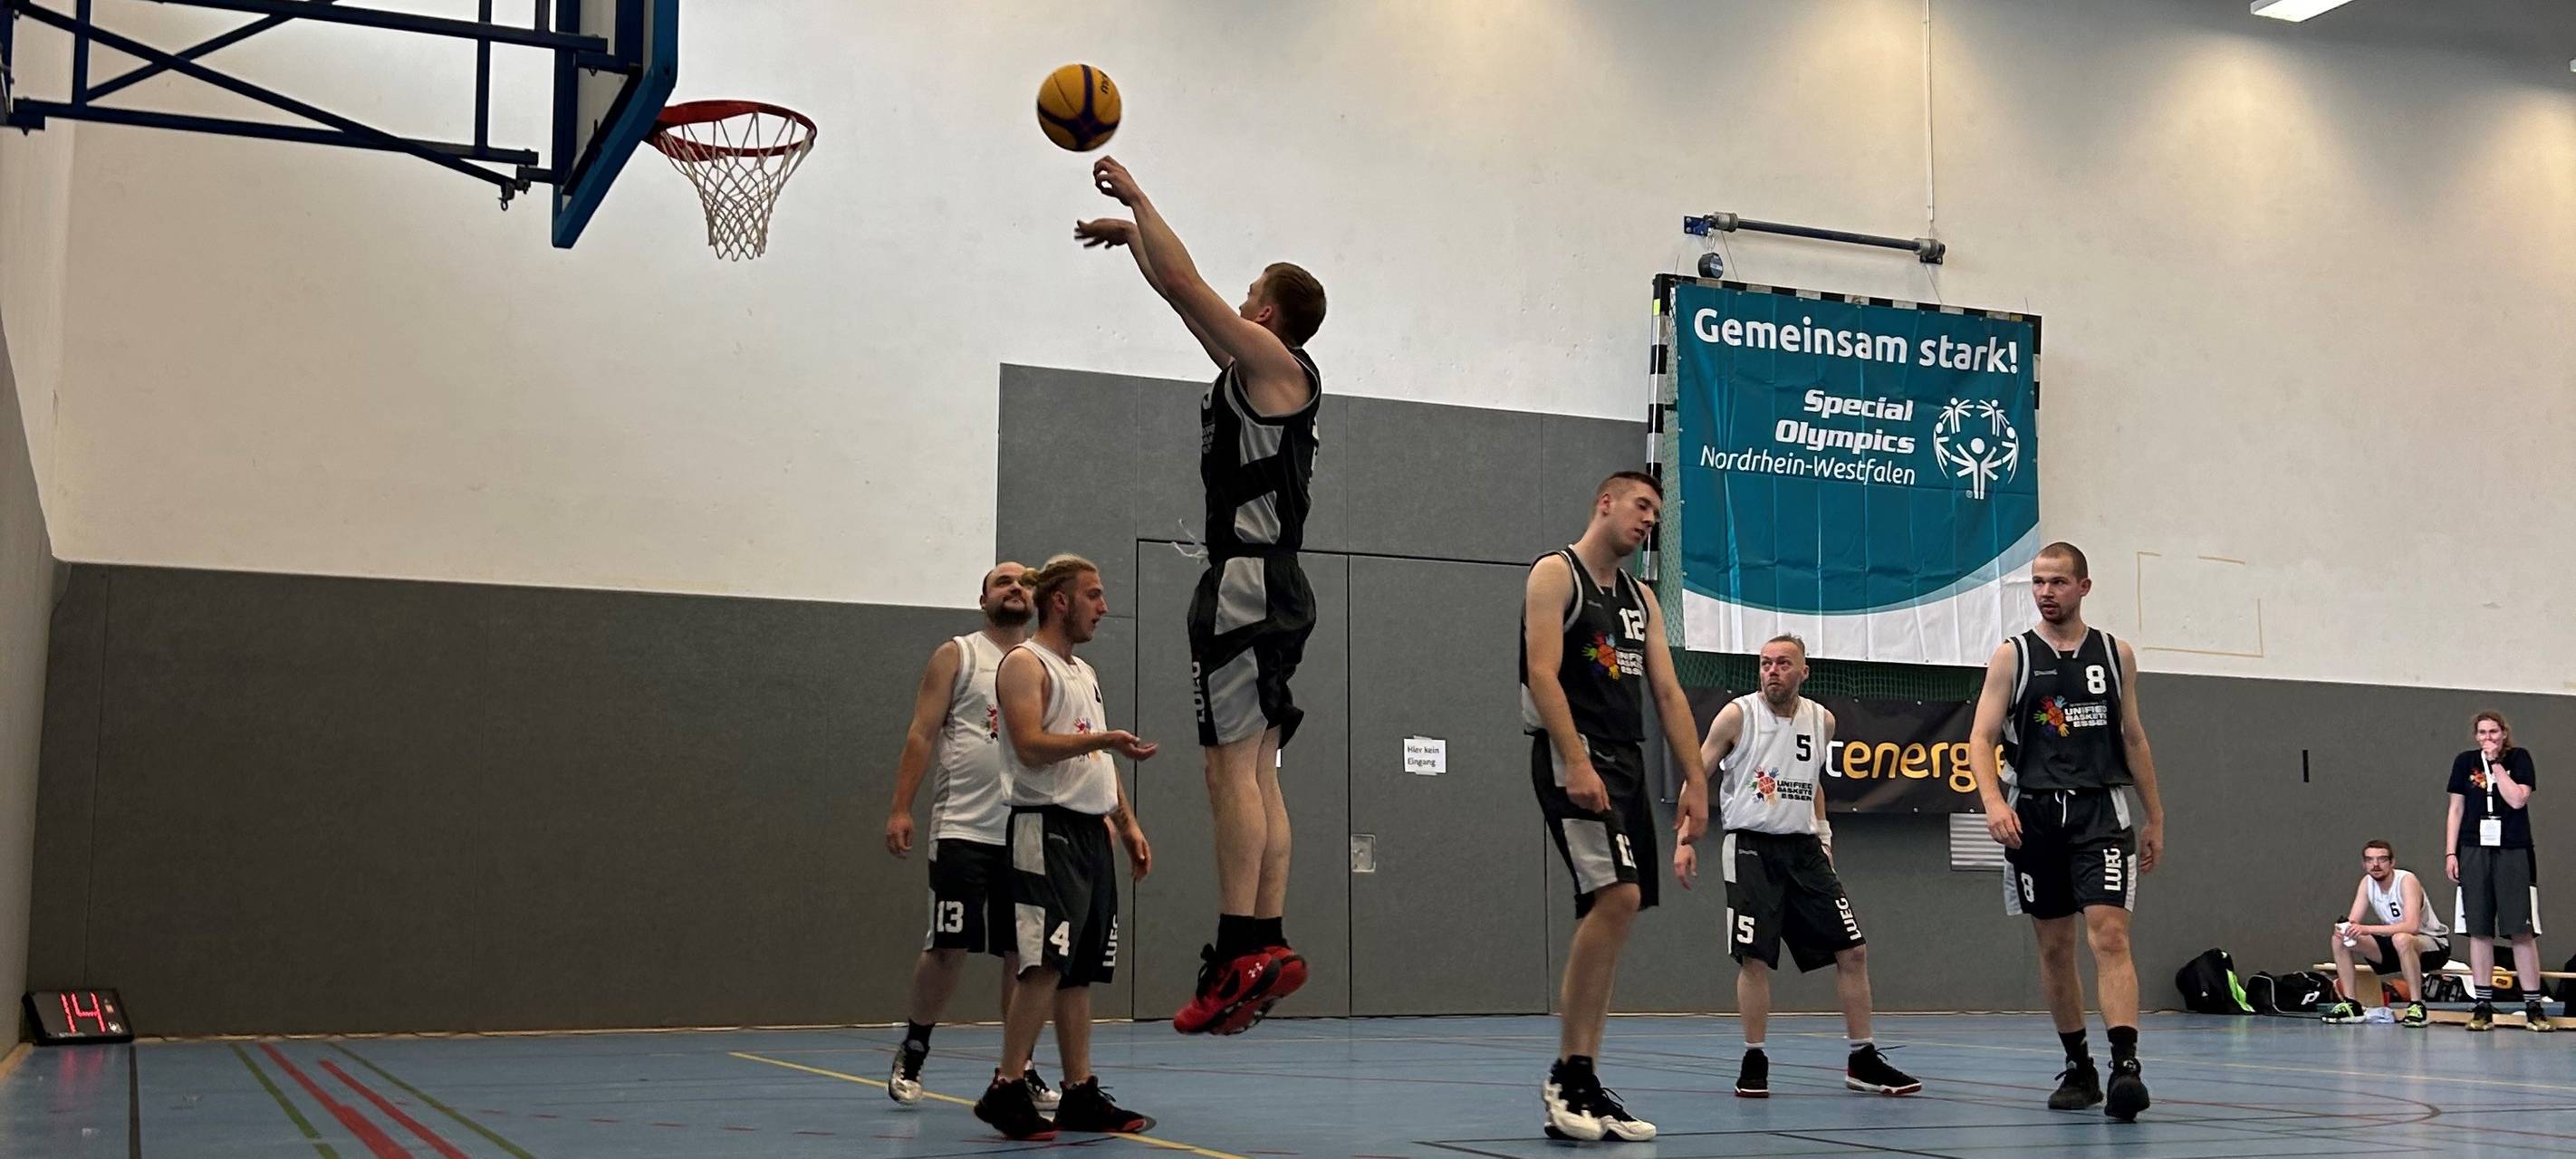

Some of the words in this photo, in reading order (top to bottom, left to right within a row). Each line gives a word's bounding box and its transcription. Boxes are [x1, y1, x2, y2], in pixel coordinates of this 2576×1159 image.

[1694, 307, 1908, 364] Gemeinsam
[1919, 337, 2018, 375] stark!
[1803, 389, 1914, 421] Special
[1774, 419, 1916, 455] Olympics
[1700, 445, 1916, 486] Nordrhein-Westfalen
[1619, 608, 1645, 642] 12
[2086, 665, 2107, 694] 8
[1407, 758, 1436, 768] Eingang
[1424, 746, 1439, 754] kein
[1796, 734, 1811, 761] 5
[1776, 780, 1812, 789] UNIFIED
[1781, 793, 1812, 801] ESSEN
[2103, 848, 2122, 891] LUEC
[2021, 872, 2035, 903] 8
[936, 900, 964, 934] 13
[1835, 897, 1862, 941] LUEC
[2389, 902, 2401, 917] 6
[1049, 920, 1072, 957] 4
[1736, 915, 1755, 944] 5
[60, 991, 107, 1034] 14
